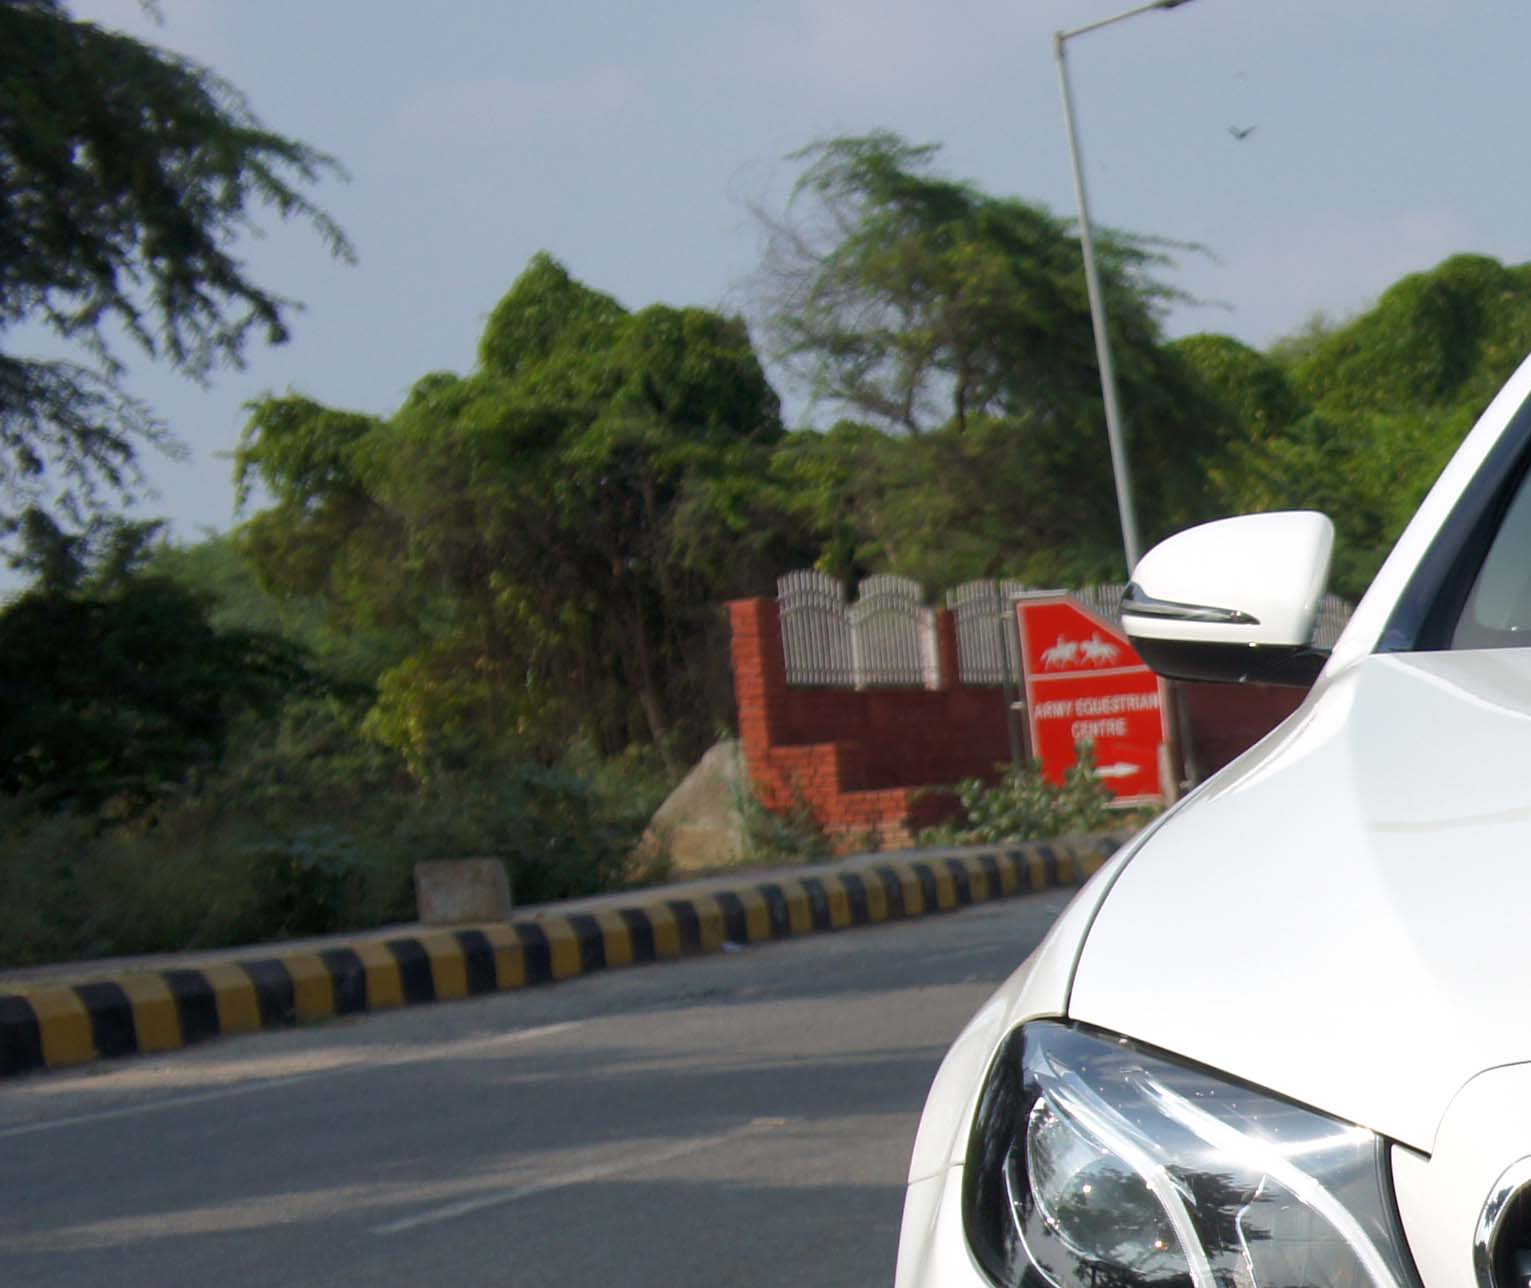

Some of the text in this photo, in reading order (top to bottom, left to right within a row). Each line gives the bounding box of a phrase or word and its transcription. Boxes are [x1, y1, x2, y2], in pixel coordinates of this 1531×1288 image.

[1034, 693, 1159, 720] ARMY EQUESTRIAN
[1071, 718, 1128, 737] CENTRE
